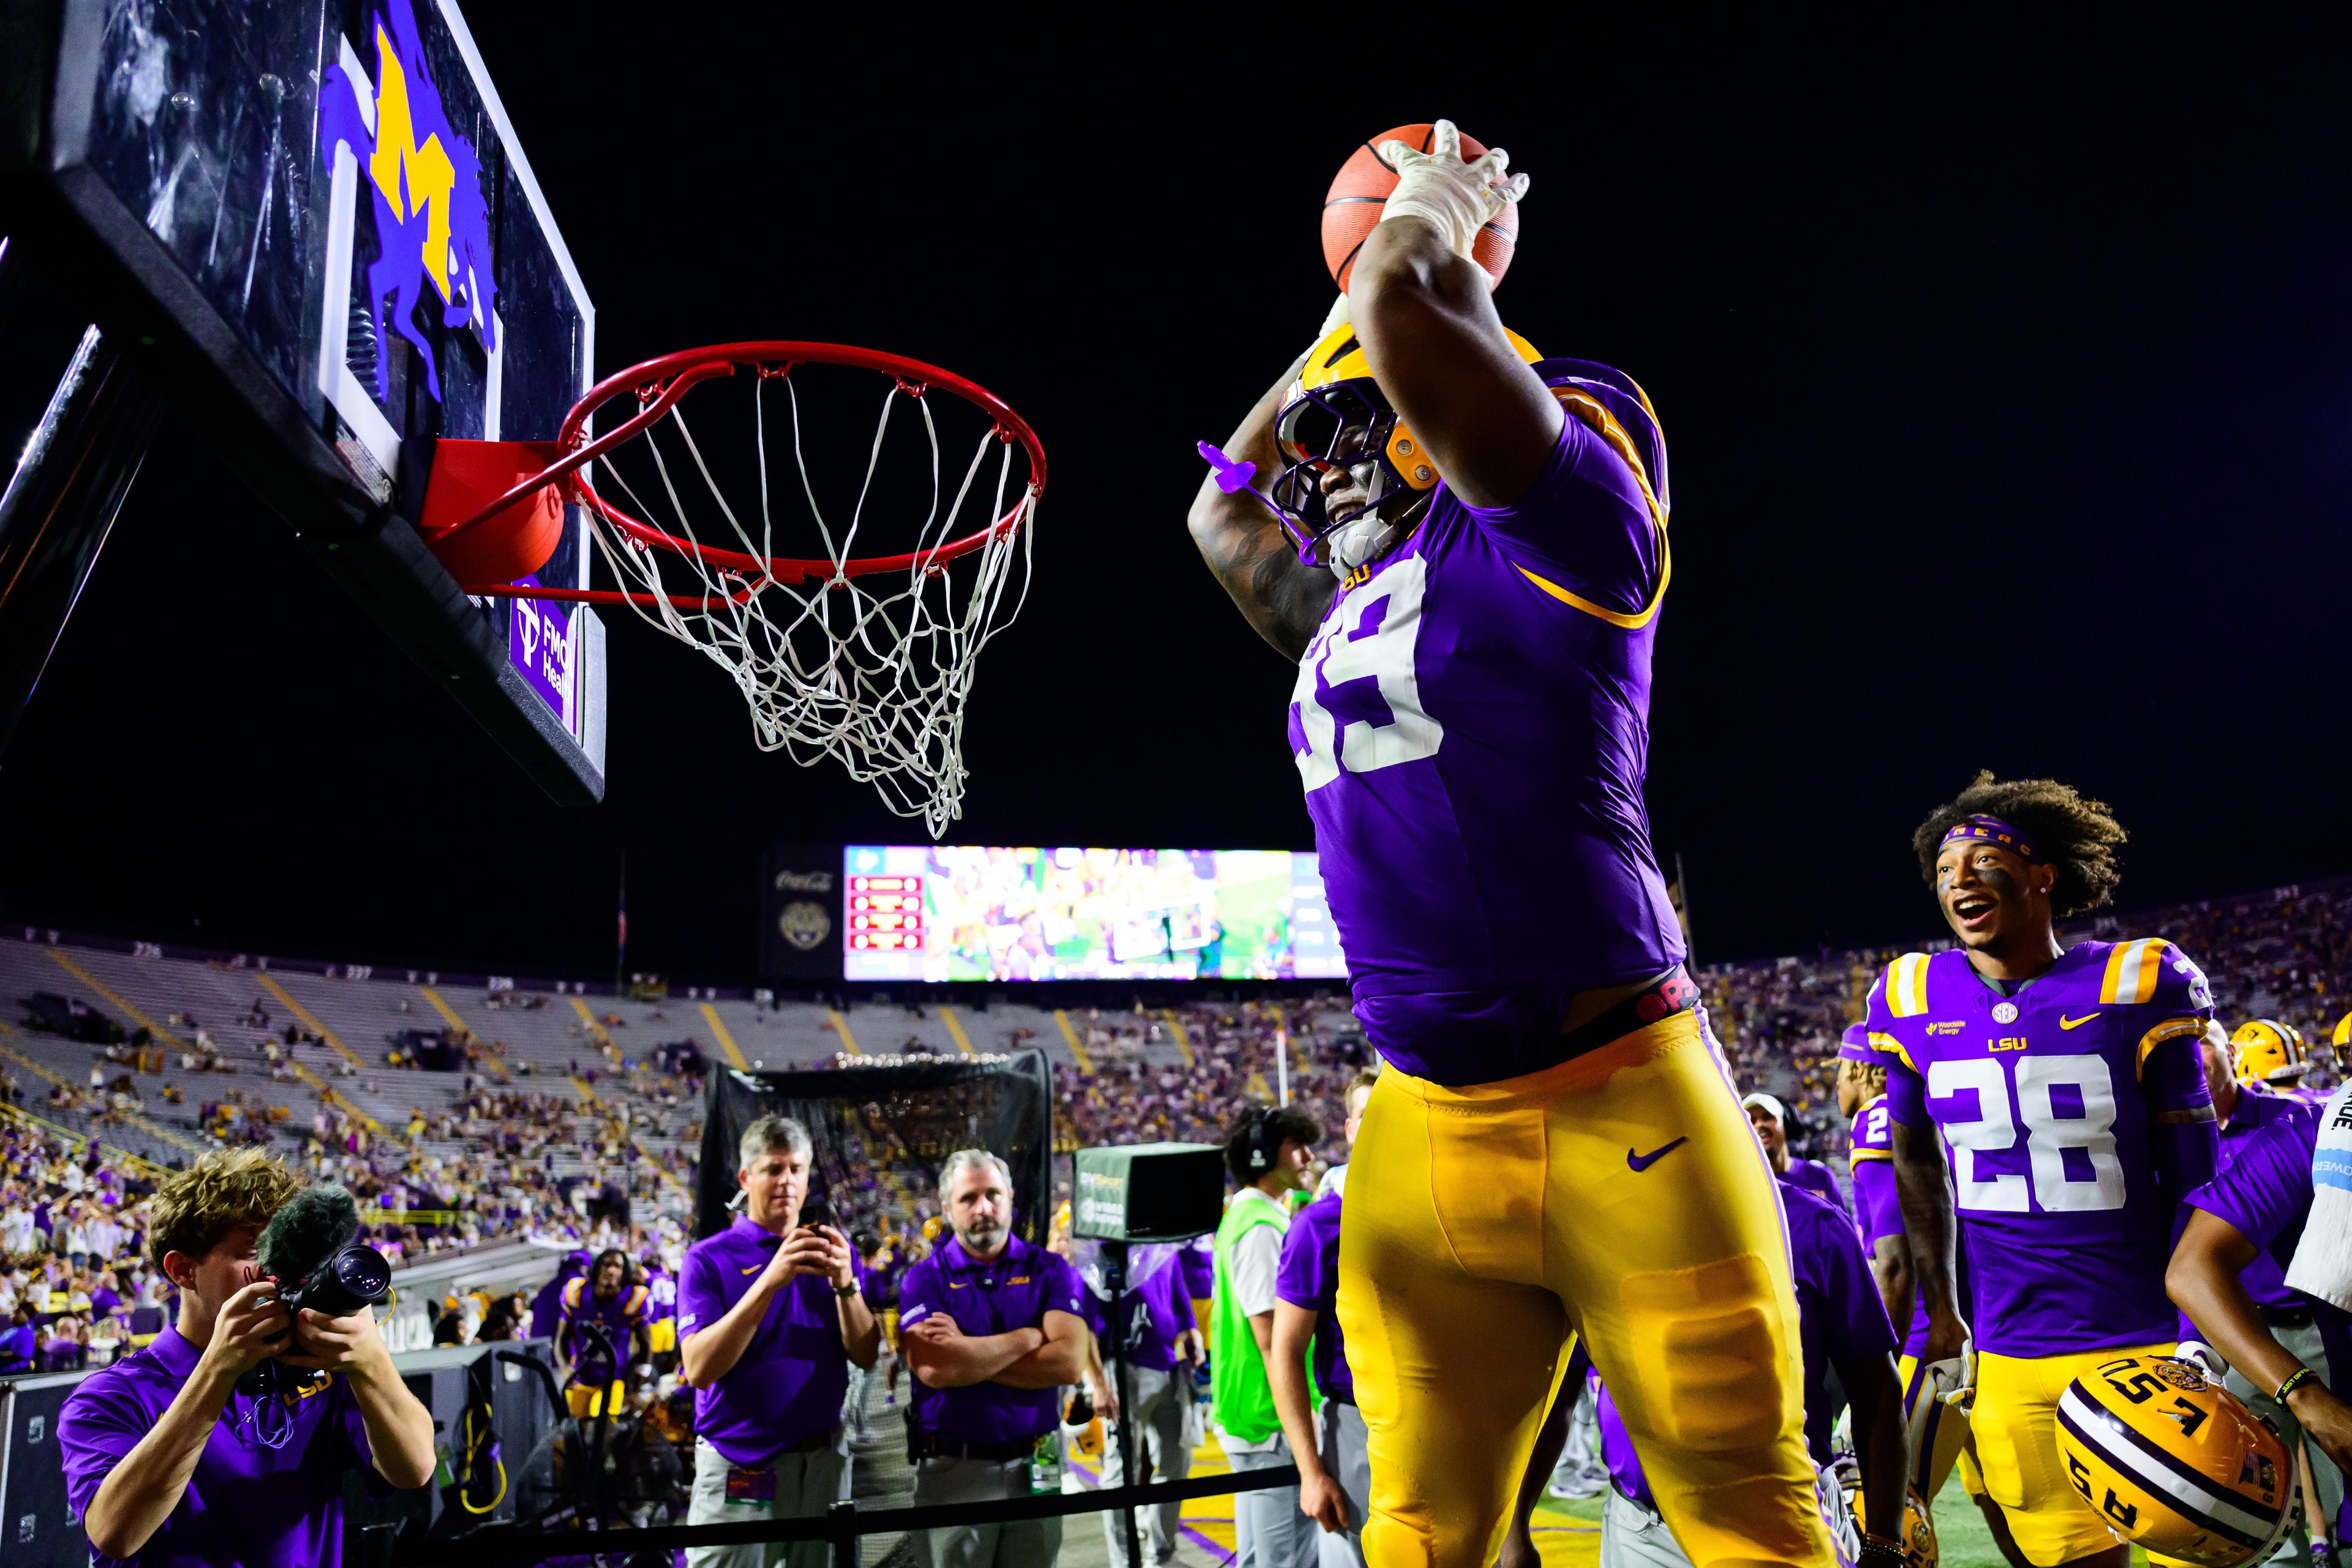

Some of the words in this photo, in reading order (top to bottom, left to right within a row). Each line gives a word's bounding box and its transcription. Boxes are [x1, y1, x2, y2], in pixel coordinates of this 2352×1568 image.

[1994, 1003, 2015, 1022] SEC
[1988, 1038, 2027, 1052] LSU
[1926, 1054, 2126, 1212] 28
[283, 1371, 333, 1407] LSU
[2097, 1358, 2209, 1438] LSU
[2282, 1378, 2295, 1393] JUST
